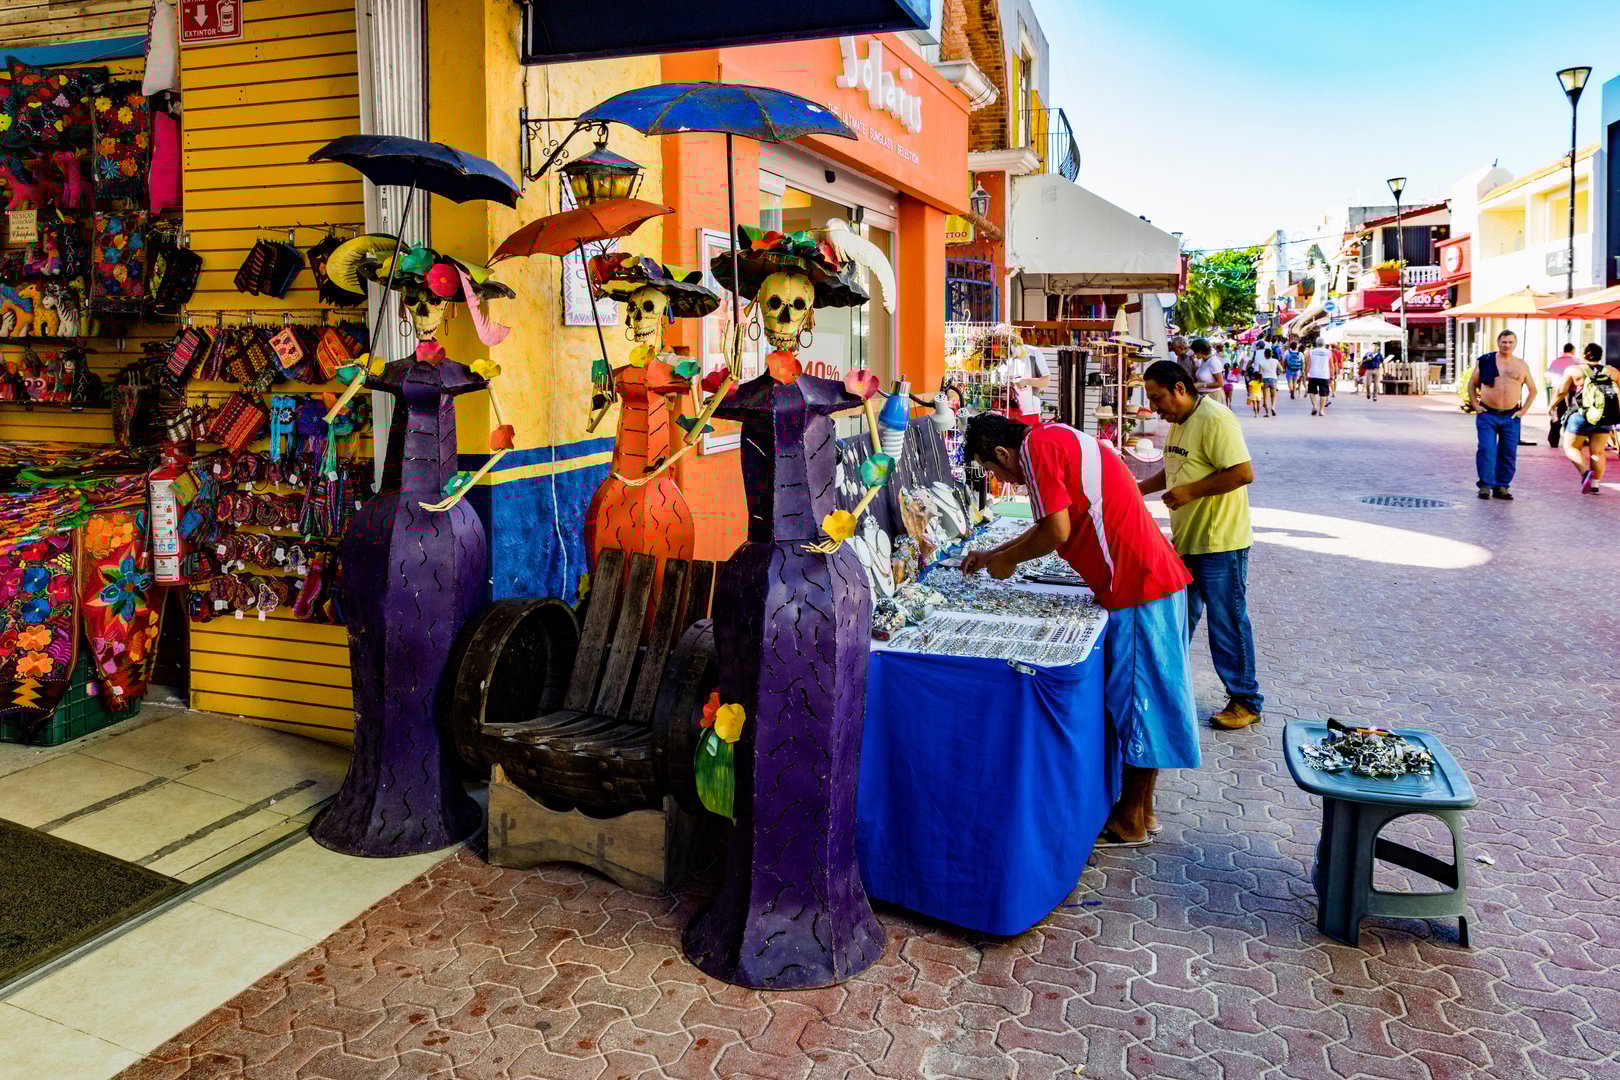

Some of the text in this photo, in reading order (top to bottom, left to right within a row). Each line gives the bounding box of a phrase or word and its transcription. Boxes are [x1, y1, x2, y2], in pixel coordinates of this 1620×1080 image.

[184, 29, 217, 38] EXTINTOR
[869, 127, 894, 151] SUNGLASS
[896, 143, 919, 165] SELECTION
